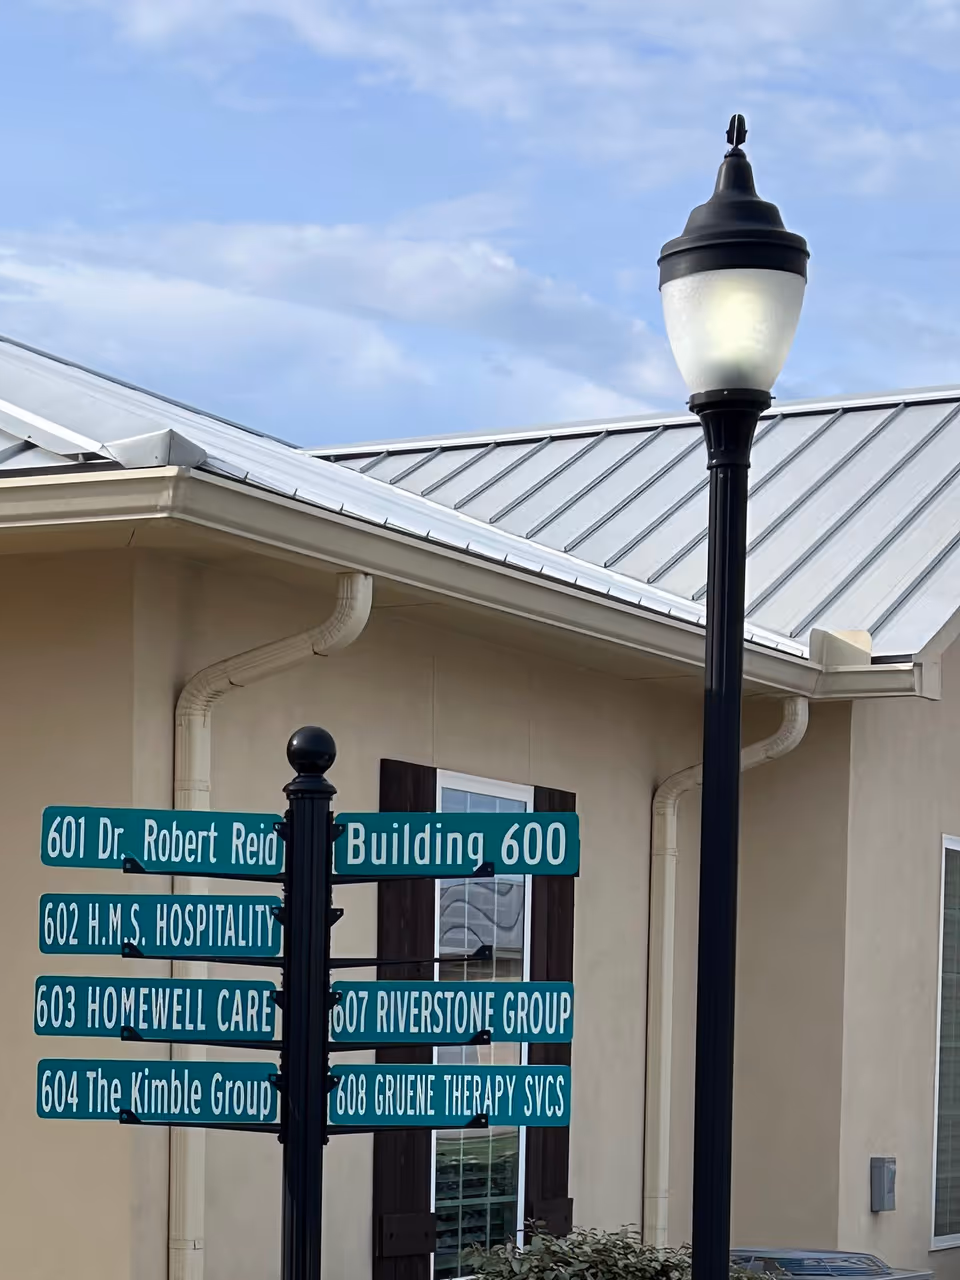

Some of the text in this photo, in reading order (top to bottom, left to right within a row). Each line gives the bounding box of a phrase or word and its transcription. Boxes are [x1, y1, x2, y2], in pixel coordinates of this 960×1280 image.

[47, 816, 277, 866] 601 Dr. Robert Reid
[347, 822, 566, 870] Building 600
[44, 902, 274, 948] 602 H.M.S. HOSPITALITY
[36, 985, 271, 1032] 603 HOMEWELL CARE
[332, 990, 571, 1034] 607 RIVERSTONE GROUP
[42, 1068, 271, 1120] 604 The Kimble Group
[336, 1074, 565, 1117] 608 GRUENE THERAPY SVCS
